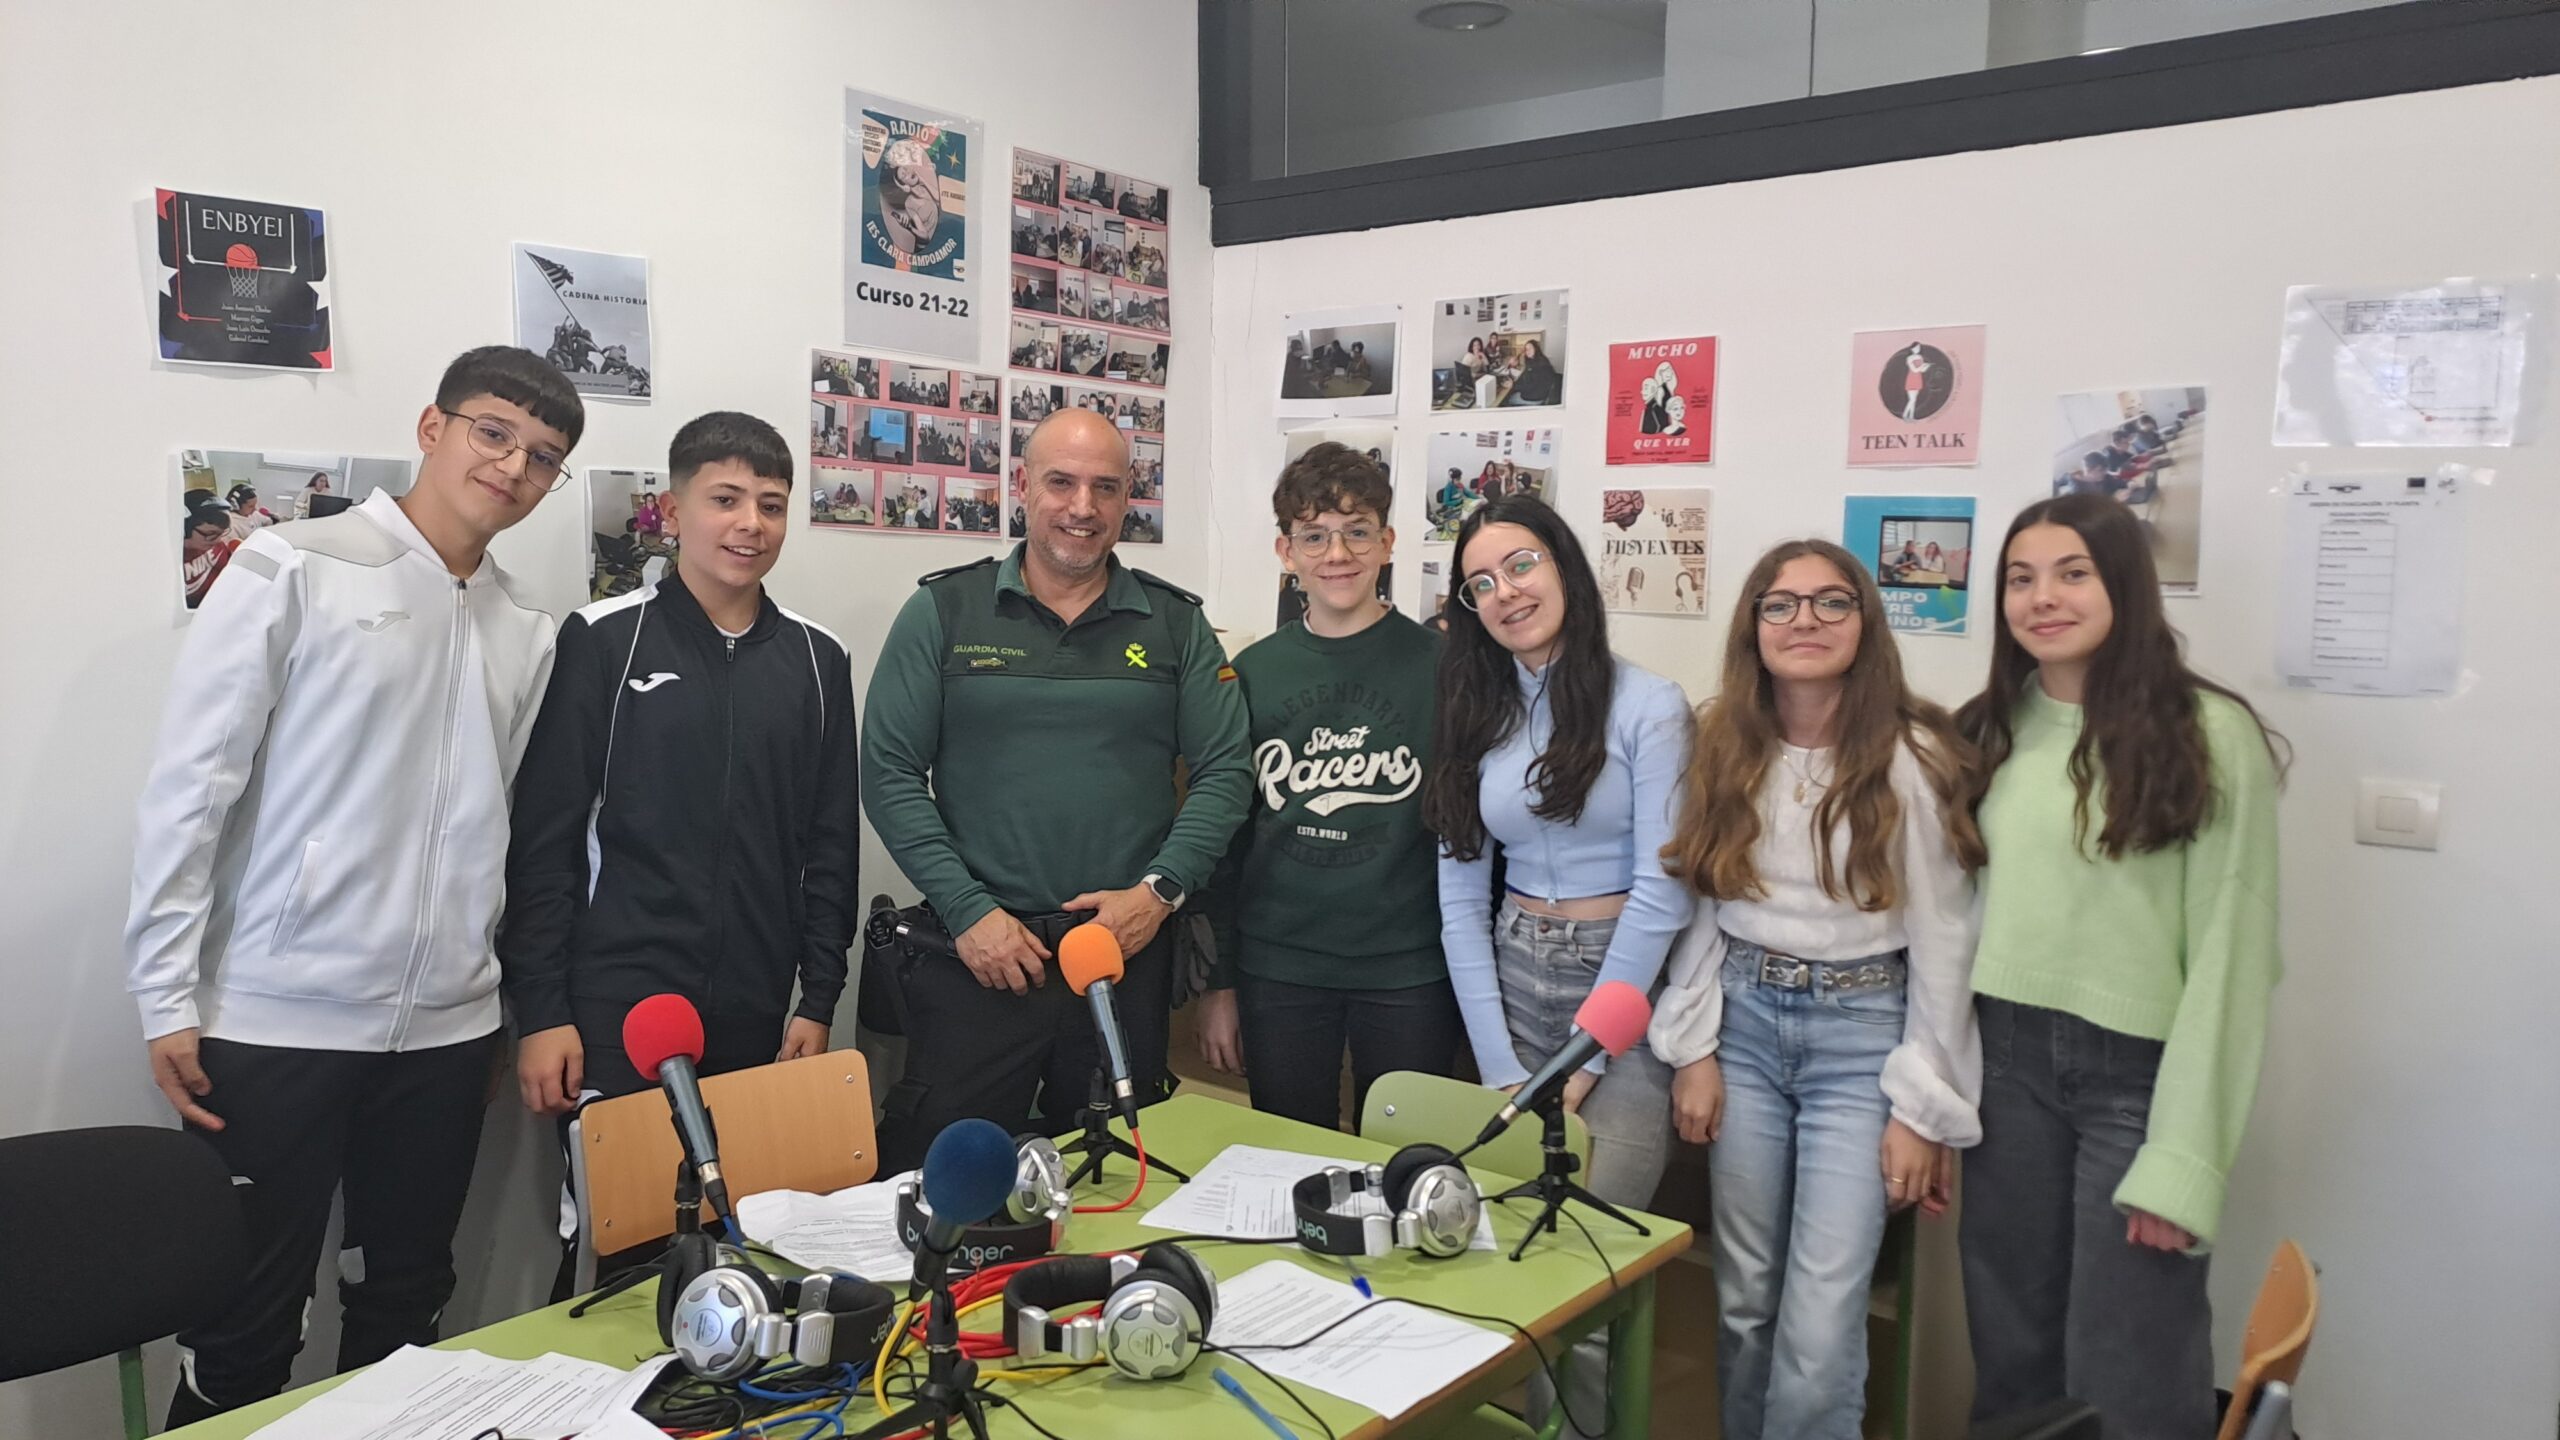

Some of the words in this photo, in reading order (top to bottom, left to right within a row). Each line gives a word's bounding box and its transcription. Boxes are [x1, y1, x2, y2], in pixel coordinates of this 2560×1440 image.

[889, 120, 930, 142] RADIO
[202, 208, 283, 238] ENBYEI
[866, 220, 881, 239] IES
[878, 236, 905, 262] CLARA
[906, 238, 958, 267] CAMPOAMOR
[562, 290, 600, 301] CADENA
[603, 295, 648, 306] HISTORIA
[856, 282, 914, 308] Curso
[919, 292, 969, 317] 21-22
[1627, 343, 1698, 360] MUCHO
[1633, 438, 1661, 450] QUE
[1665, 437, 1691, 447] VER
[1862, 434, 1909, 450] TEEN
[1913, 432, 1966, 448] TALK
[184, 549, 216, 581] NIKE
[1880, 591, 1928, 603] MPO
[953, 645, 998, 654] GUARDIA
[1001, 647, 1027, 656] CIVIL
[1273, 682, 1406, 729] LEGENDARY
[1303, 725, 1371, 756] Street
[1253, 738, 1423, 816] Racers
